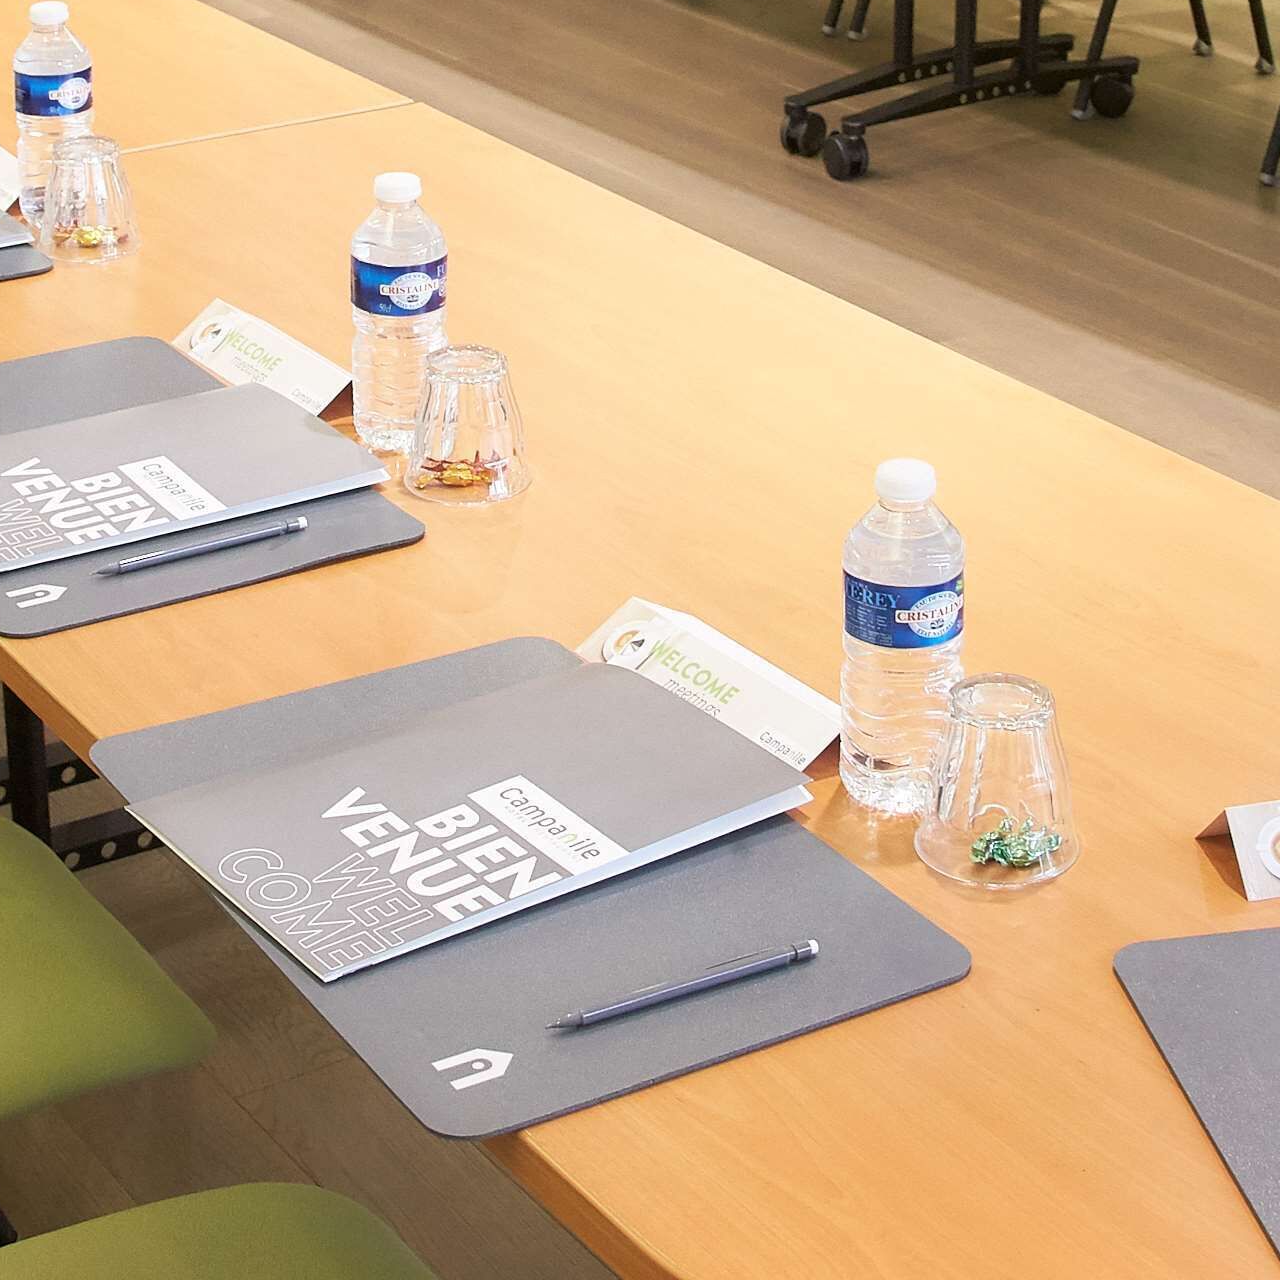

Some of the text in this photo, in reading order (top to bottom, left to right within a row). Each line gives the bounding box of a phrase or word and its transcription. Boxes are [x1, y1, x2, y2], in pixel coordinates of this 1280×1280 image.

[225, 328, 283, 371] WELCOME
[0, 456, 121, 546] VENUE
[70, 471, 171, 533] BIEN
[651, 638, 740, 705] WELCOME
[759, 731, 807, 765] Campanile
[320, 786, 506, 922] VENUE
[414, 804, 563, 899] BIEN
[500, 787, 601, 860] Campanile
[218, 848, 388, 970] COME
[313, 853, 434, 949] WEL
